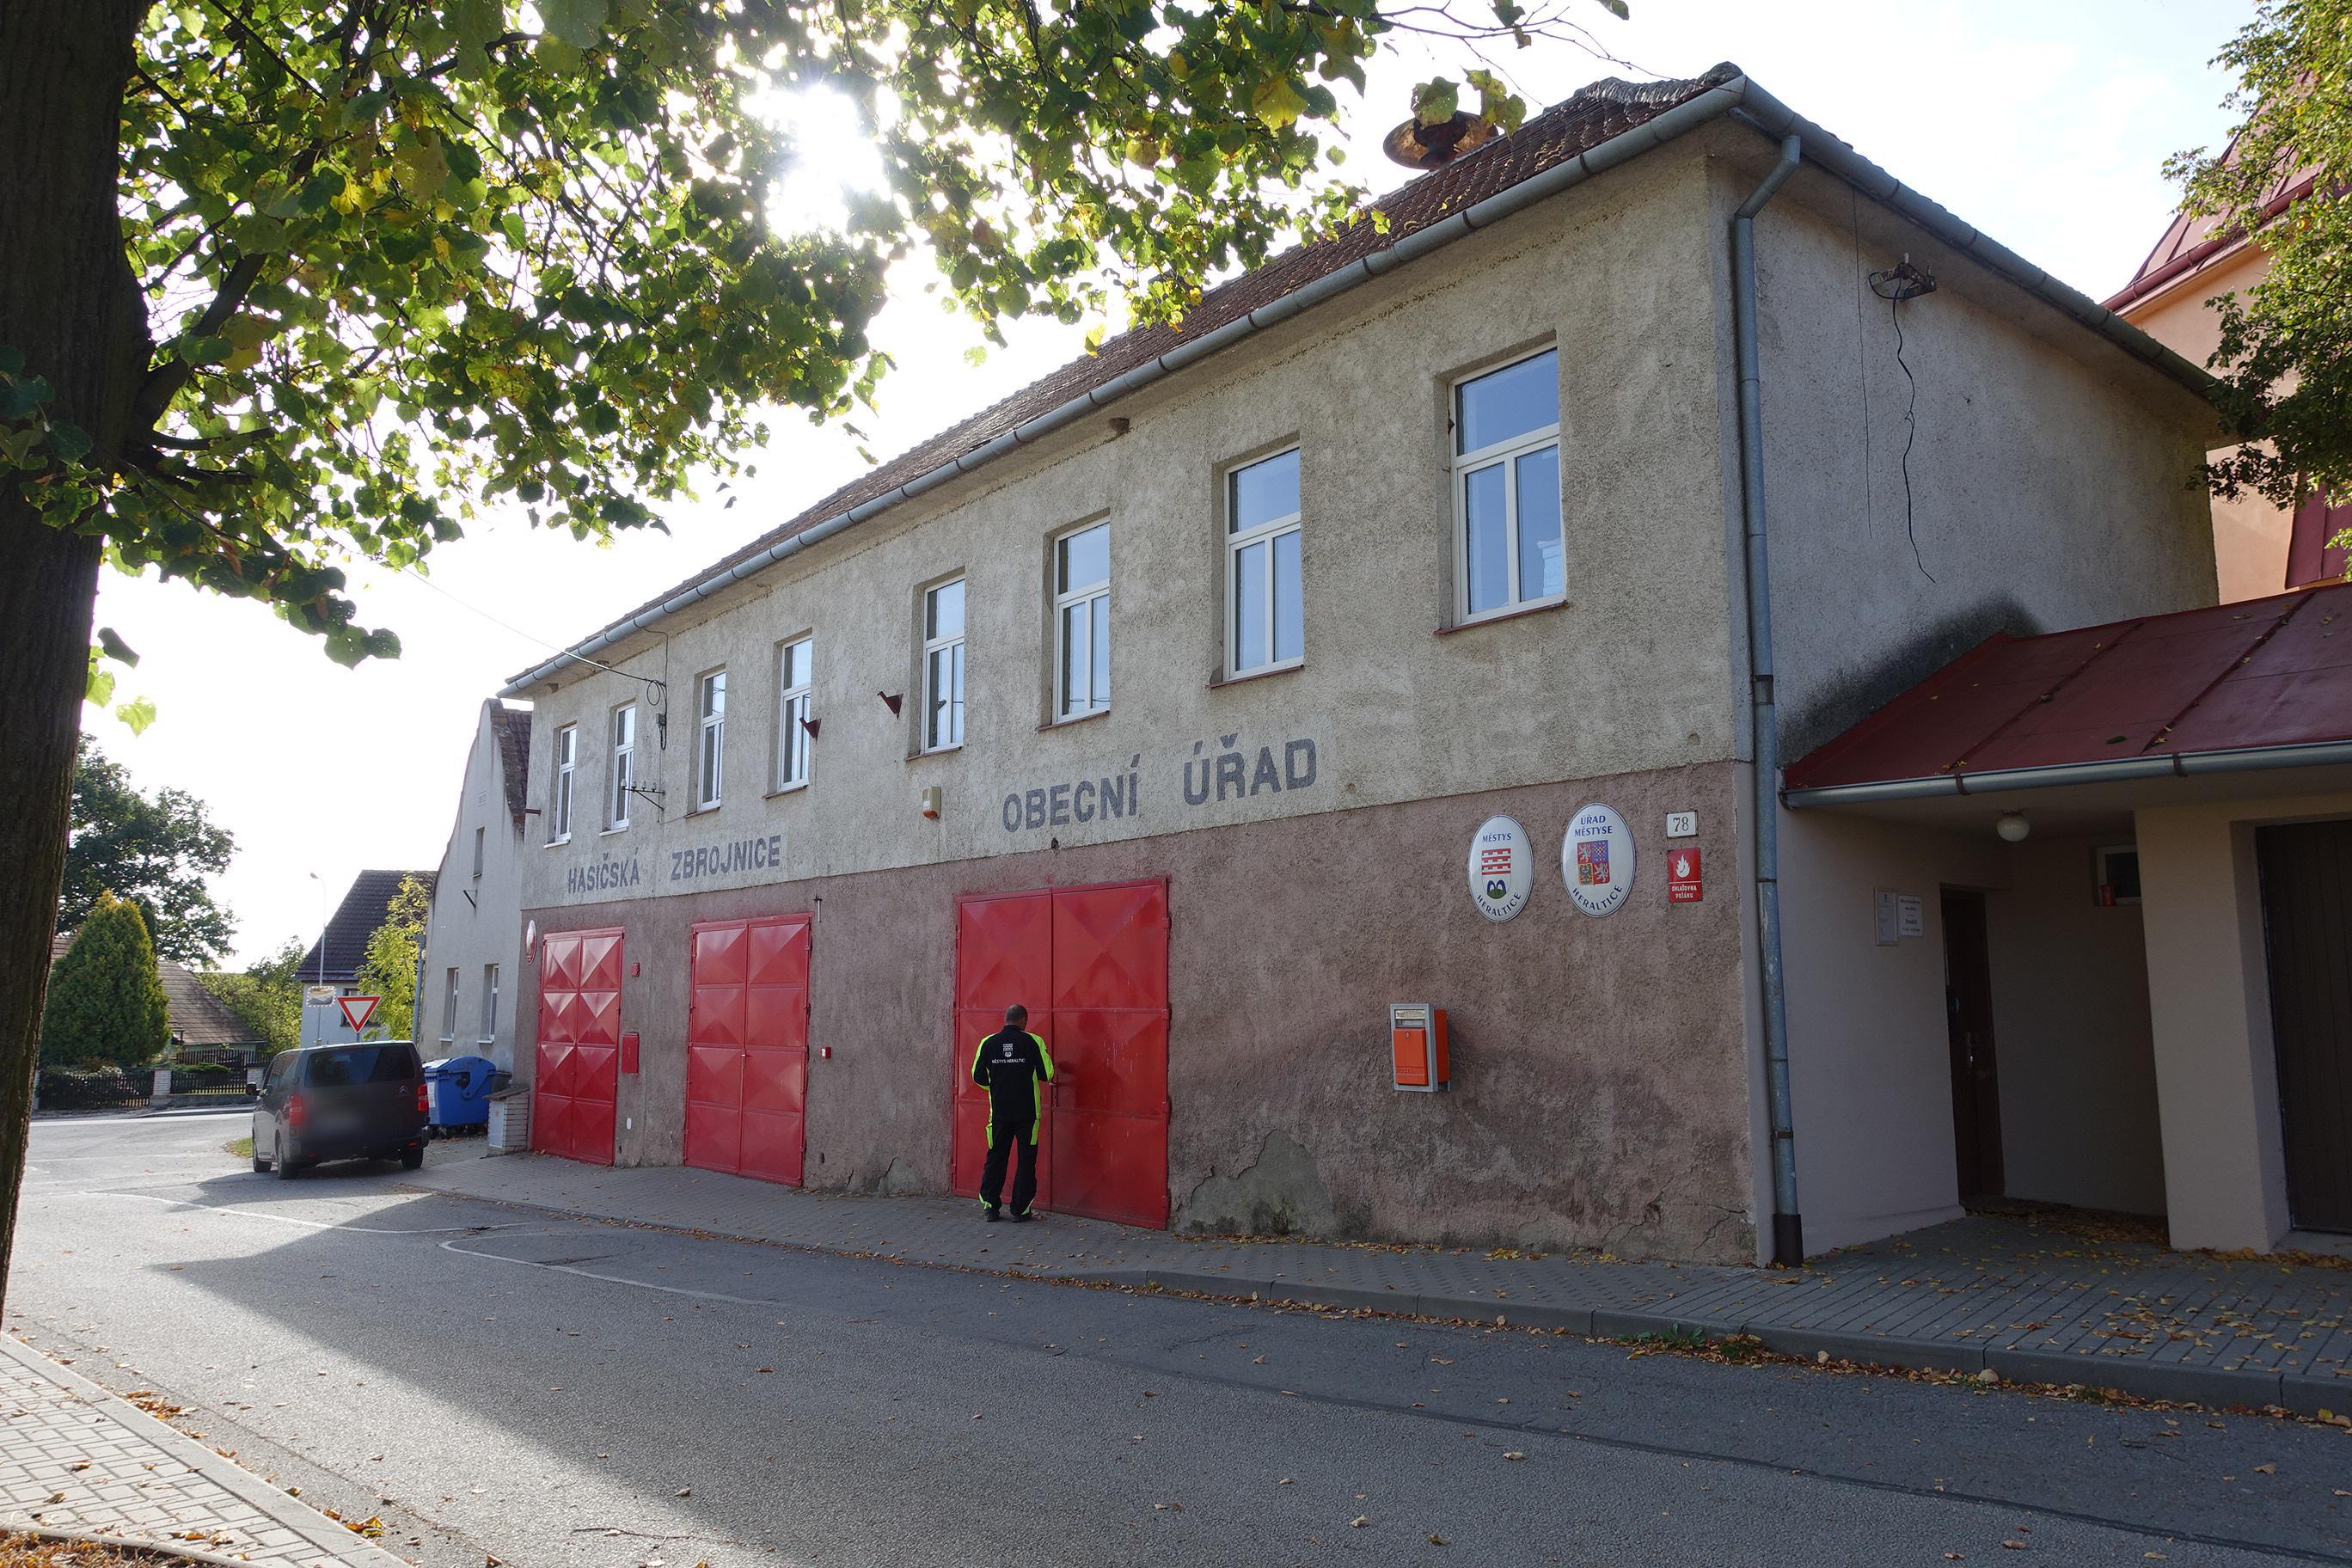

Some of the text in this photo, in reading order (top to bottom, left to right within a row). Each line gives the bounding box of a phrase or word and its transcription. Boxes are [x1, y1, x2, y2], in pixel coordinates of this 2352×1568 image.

[1002, 732, 1317, 833] OBECNÍ ÚŘAD
[1580, 814, 1606, 825] ÚŘAD
[1673, 817, 1689, 832] 78
[1482, 832, 1512, 842] MĚSTYS
[1574, 825, 1613, 836] MĚSTYSE
[567, 835, 781, 893] HASIČSKÁ ZBROJNICE
[1477, 892, 1522, 916] HERALTICE
[1572, 885, 1623, 910] HERALTICE
